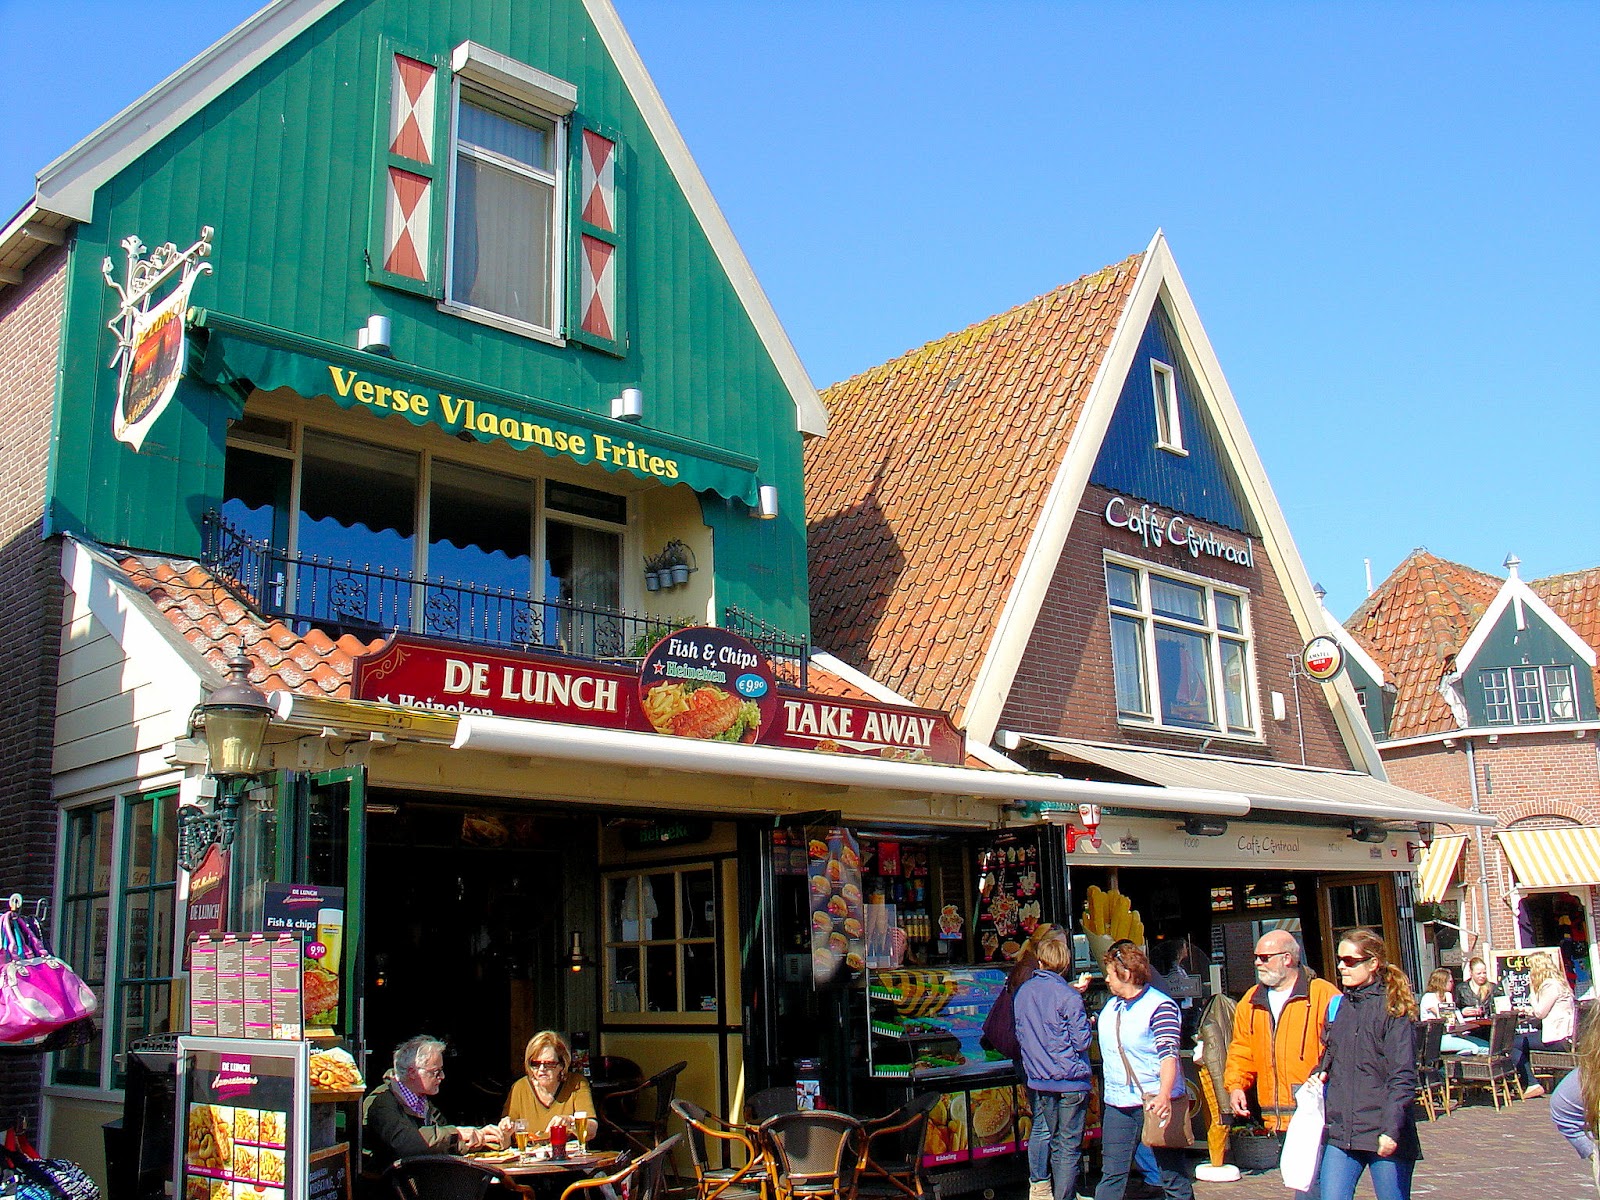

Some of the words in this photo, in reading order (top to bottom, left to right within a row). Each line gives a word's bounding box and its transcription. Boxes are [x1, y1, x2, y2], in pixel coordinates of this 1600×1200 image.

[328, 365, 429, 416] Verse
[438, 394, 586, 456] Vlaamse
[592, 434, 680, 479] Frites
[1105, 497, 1164, 548] Café
[1167, 516, 1255, 568] Centraal
[667, 638, 699, 659] Fish
[702, 643, 716, 661] &
[719, 646, 758, 669] Chips
[665, 660, 727, 683] Heineken
[443, 658, 491, 696] DE
[501, 666, 618, 713] LUNCH
[784, 700, 854, 738] TAKE
[861, 711, 936, 747] AWAY
[1262, 836, 1300, 853] Centraal
[198, 903, 219, 919] LUNCH
[267, 917, 285, 927] Fish
[286, 918, 294, 928] &
[295, 918, 317, 931] chips
[222, 1062, 230, 1071] DE
[230, 1062, 250, 1073] LUNCH
[982, 1144, 1007, 1154] Hamburger
